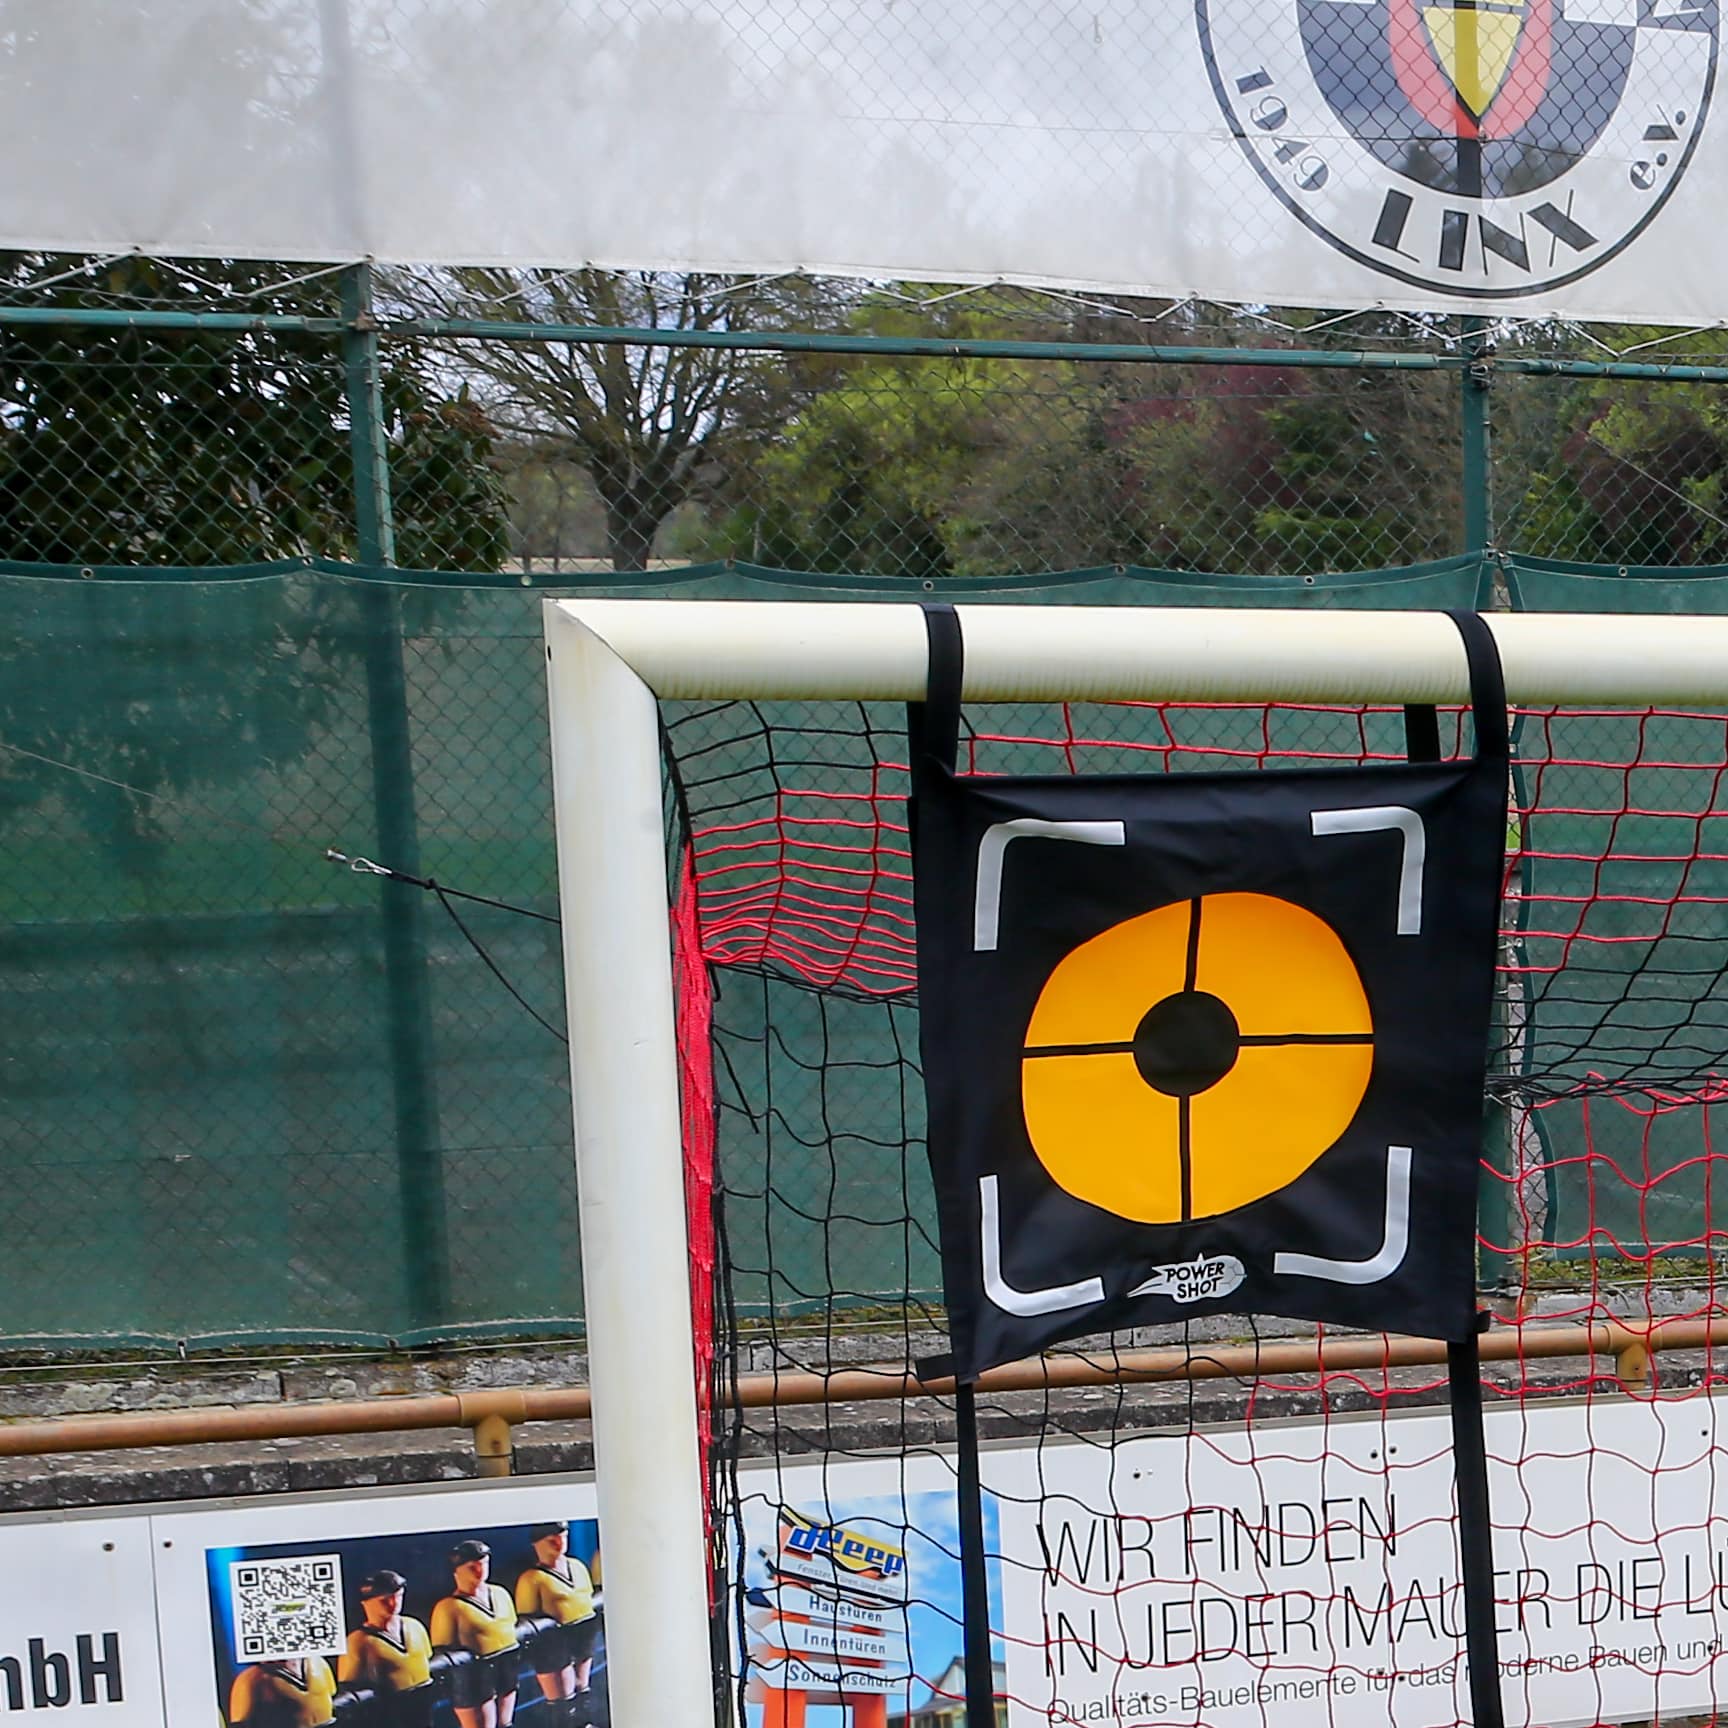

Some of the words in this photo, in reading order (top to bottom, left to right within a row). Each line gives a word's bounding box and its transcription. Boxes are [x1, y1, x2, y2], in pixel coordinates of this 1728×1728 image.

[1235, 65, 1330, 192] 1949
[1371, 188, 1600, 276] LINX
[1629, 103, 1687, 191] e.V.
[1164, 1261, 1225, 1283] POWER
[1176, 1276, 1225, 1299] SHOT
[1035, 1517, 1156, 1587] WIR
[1183, 1494, 1397, 1575] FINDEN
[1043, 1608, 1098, 1677] IN
[1124, 1591, 1319, 1669] JEDER
[1576, 1557, 1662, 1625] DIE
[1047, 1671, 1357, 1724] Qualitäts-Bauelemente
[1408, 1661, 1456, 1688] das
[1588, 1644, 1668, 1670] Bauen
[1676, 1633, 1723, 1660] und
